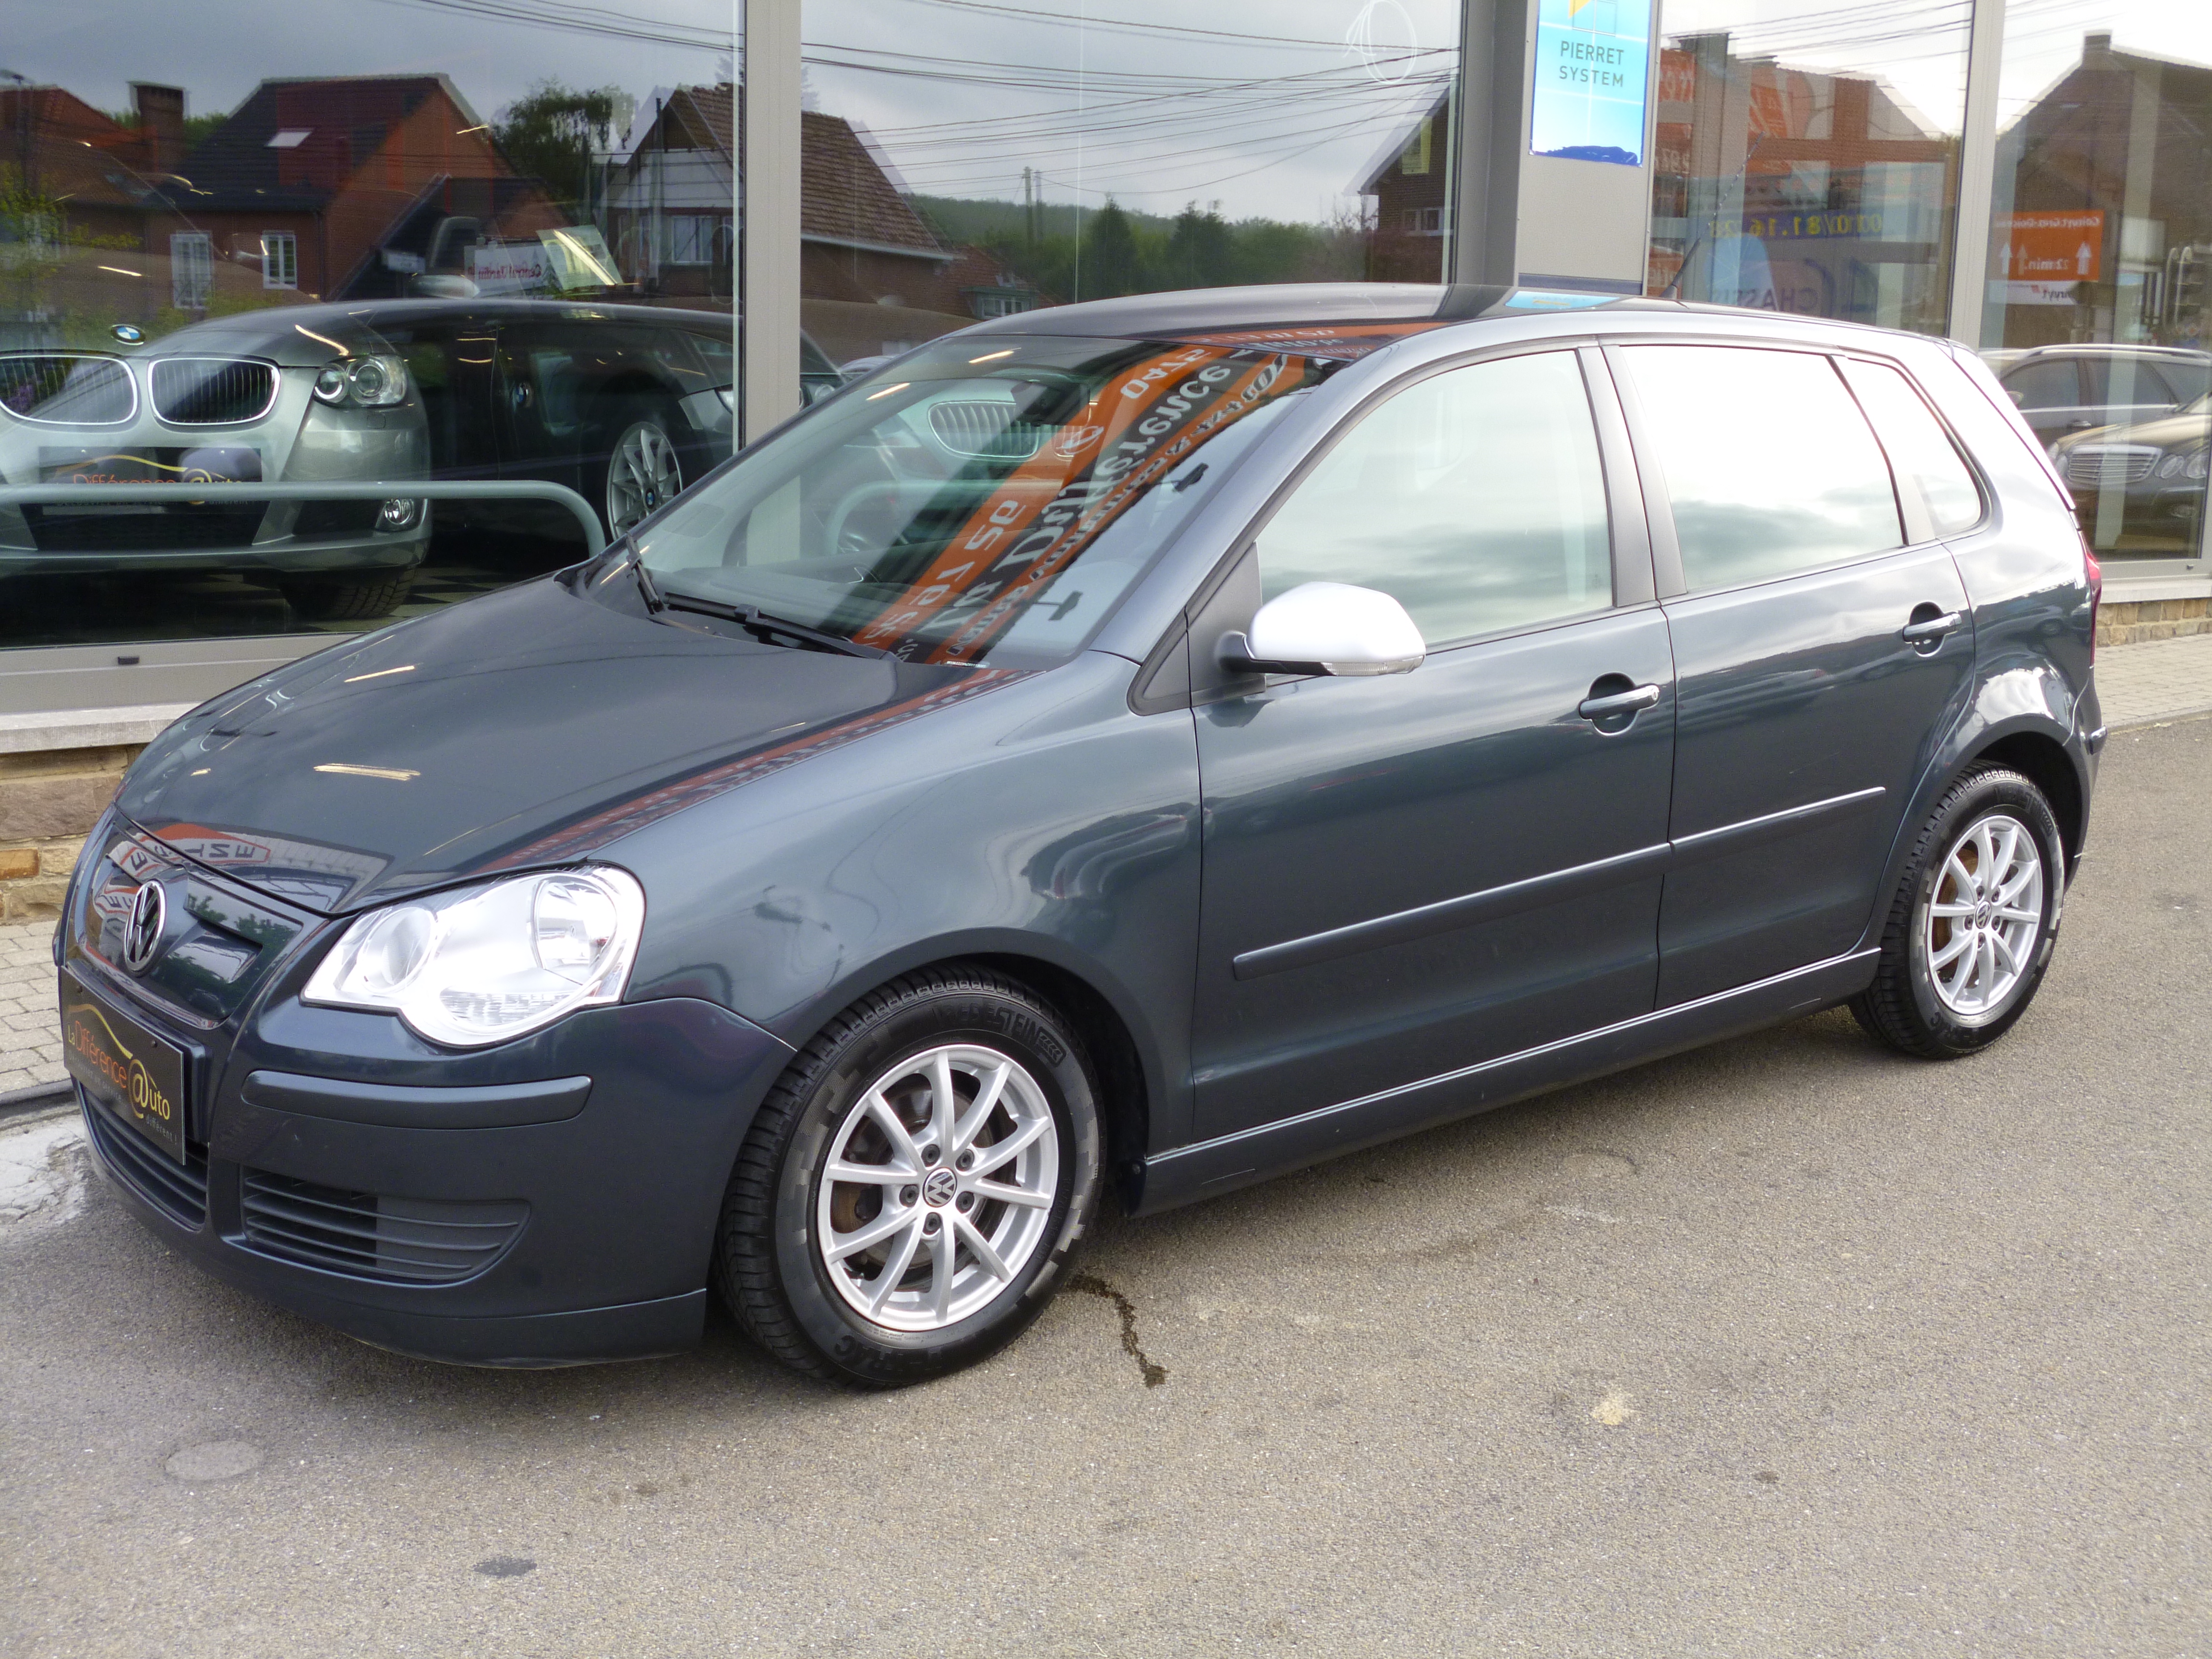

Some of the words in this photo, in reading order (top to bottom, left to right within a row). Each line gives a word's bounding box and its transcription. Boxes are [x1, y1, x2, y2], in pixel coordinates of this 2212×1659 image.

[1561, 40, 1624, 65] PIERRET
[1559, 66, 1623, 87] SYSTEM
[68, 1025, 75, 1046] La
[75, 1021, 127, 1089] Différence
